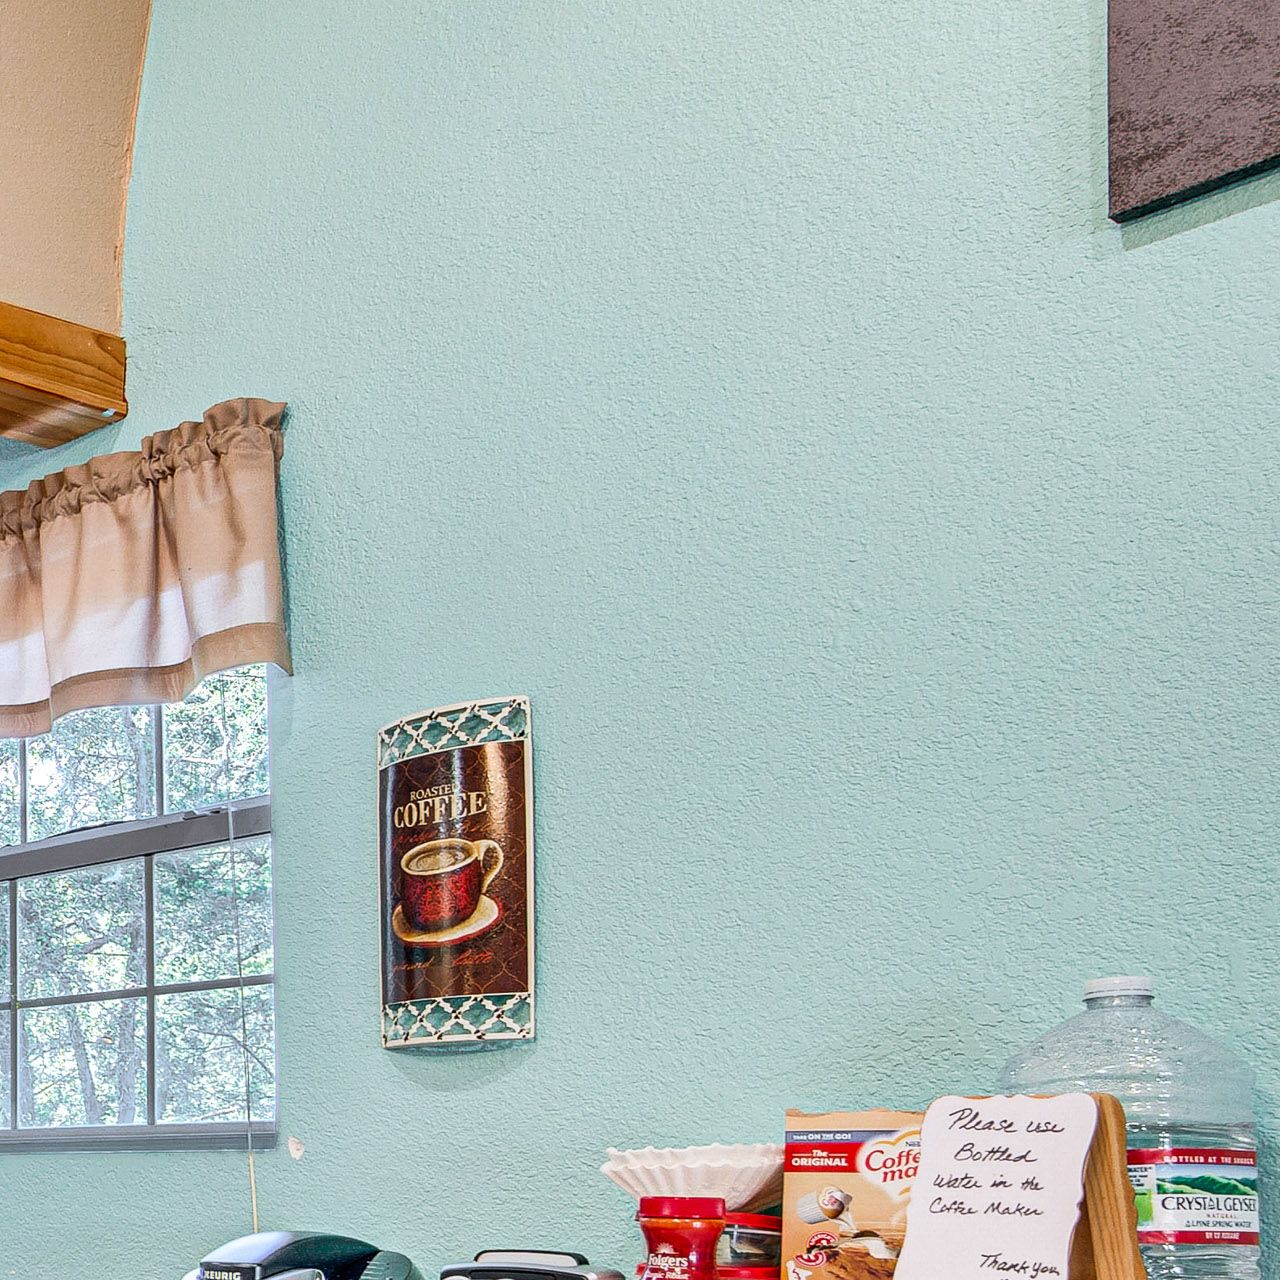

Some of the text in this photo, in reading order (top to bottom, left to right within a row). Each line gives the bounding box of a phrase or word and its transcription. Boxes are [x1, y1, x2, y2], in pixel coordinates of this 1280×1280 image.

[394, 791, 488, 829] COFFEE
[948, 1108, 1065, 1133] Please use
[808, 1133, 821, 1141] ON
[834, 1133, 852, 1141] GO!
[811, 1149, 829, 1158] The
[864, 1148, 922, 1173] Coffe
[954, 1142, 1038, 1163] Bottled
[1163, 1155, 1204, 1164] BOTTLED
[1207, 1156, 1217, 1164] AT
[1220, 1156, 1232, 1164] THE
[792, 1157, 849, 1167] ORIGINAL
[882, 1165, 919, 1184] ma
[990, 1175, 1013, 1188] in
[1020, 1176, 1044, 1191] the
[928, 1197, 1045, 1217] Coffee Maker
[1161, 1196, 1222, 1211] CRYSTAL
[648, 1253, 689, 1271] Folgers
[978, 1252, 1031, 1275] Thank
[203, 1270, 242, 1280] KEURIG
